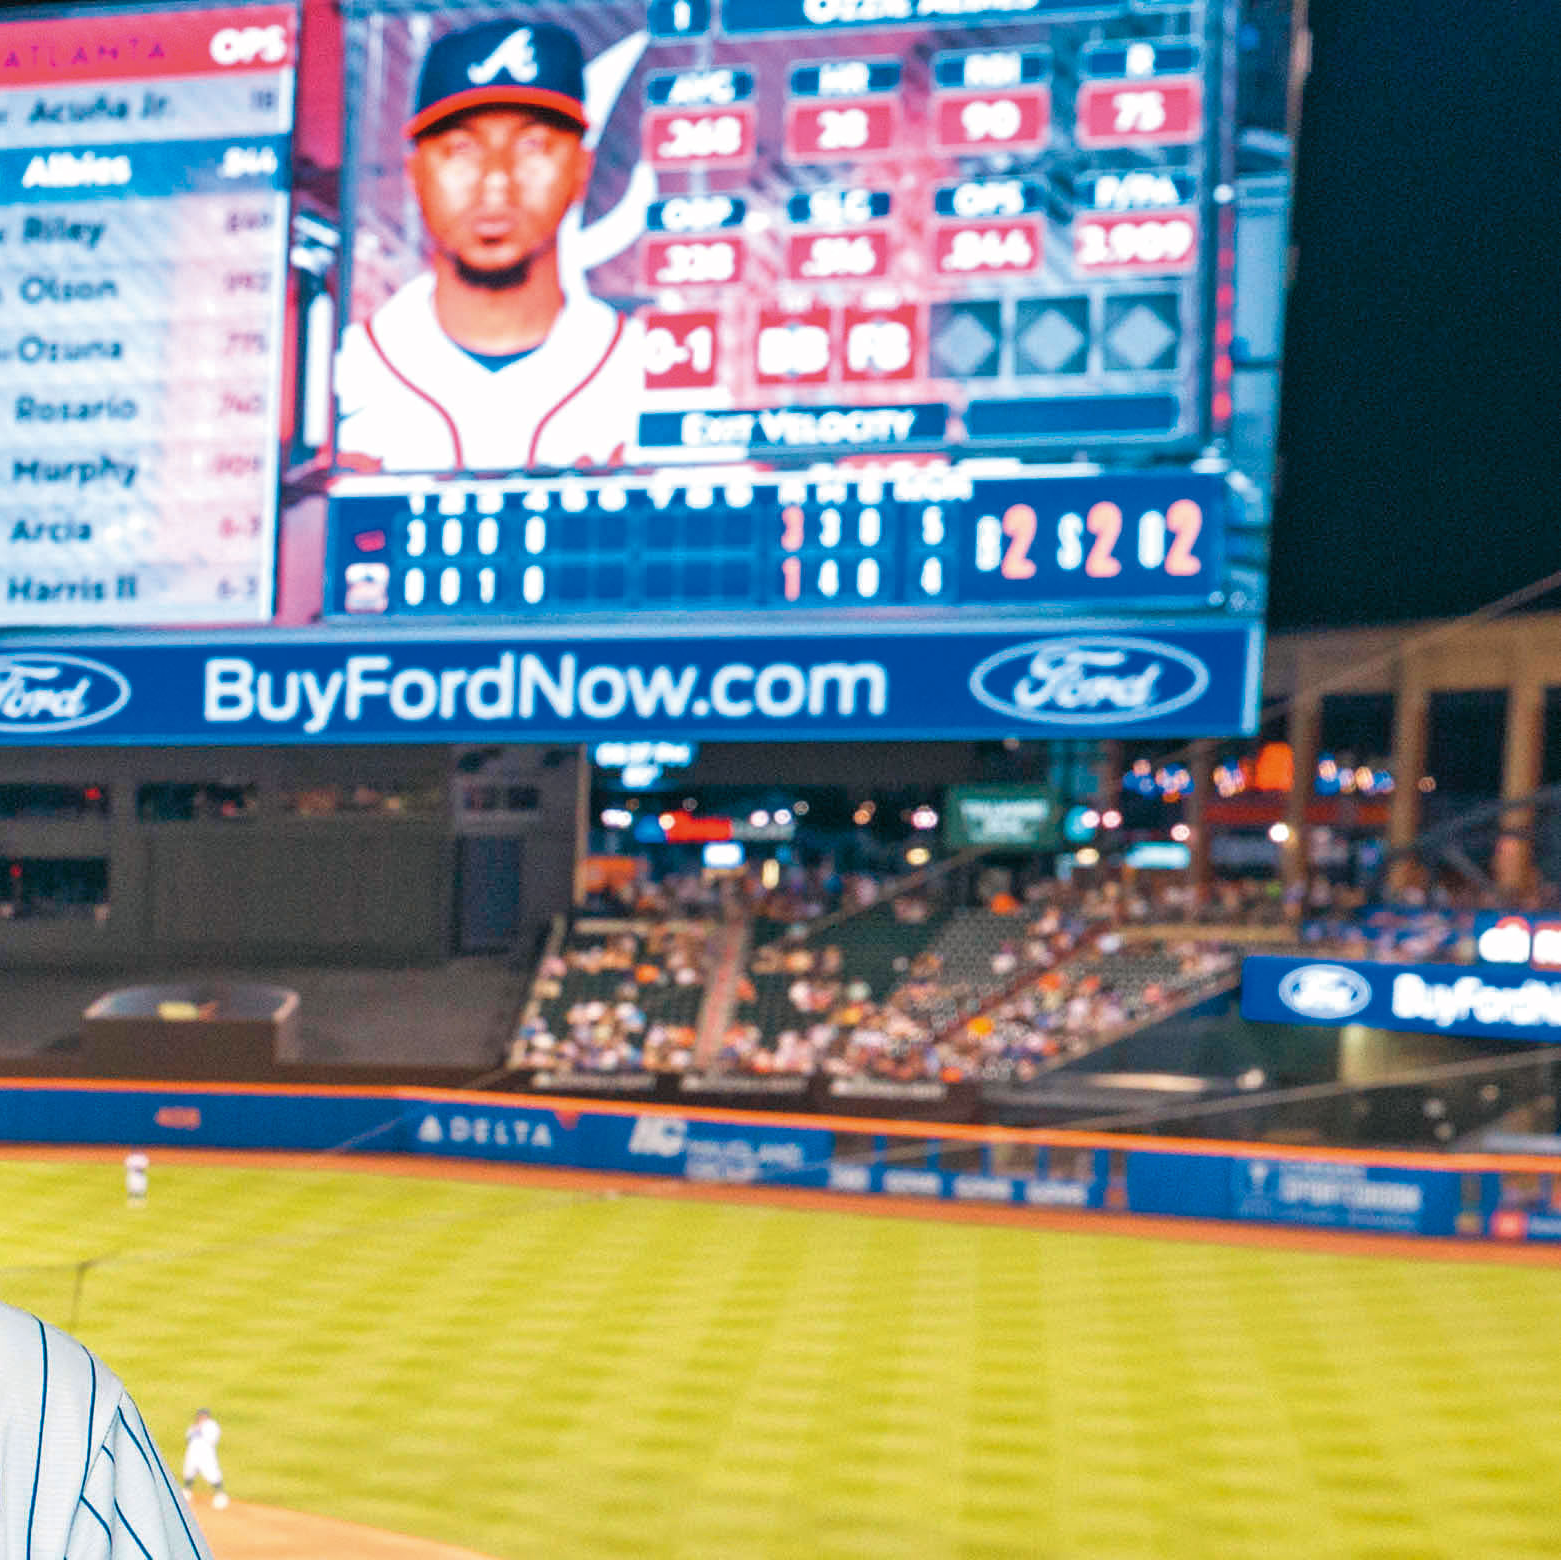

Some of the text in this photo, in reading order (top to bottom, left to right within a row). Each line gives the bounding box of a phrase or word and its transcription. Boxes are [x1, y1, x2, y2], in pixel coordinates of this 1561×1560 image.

[4, 38, 166, 67] ATLANTA
[210, 25, 286, 64] OPS
[22, 213, 107, 248] Riley
[19, 275, 118, 303] Olson
[17, 334, 123, 363] Ozuna
[15, 395, 138, 421] Rosario
[758, 408, 916, 444] VELOCITY
[11, 453, 138, 489] Murphy
[9, 520, 92, 543] Arcia
[1001, 504, 1037, 580] 2
[1085, 501, 1123, 578] 2
[1164, 499, 1202, 576] 2
[7, 577, 105, 602] Harris
[203, 651, 888, 734] BuyFordNow.com
[1013, 645, 1163, 711] Ford
[450, 1115, 554, 1149] DELTA
